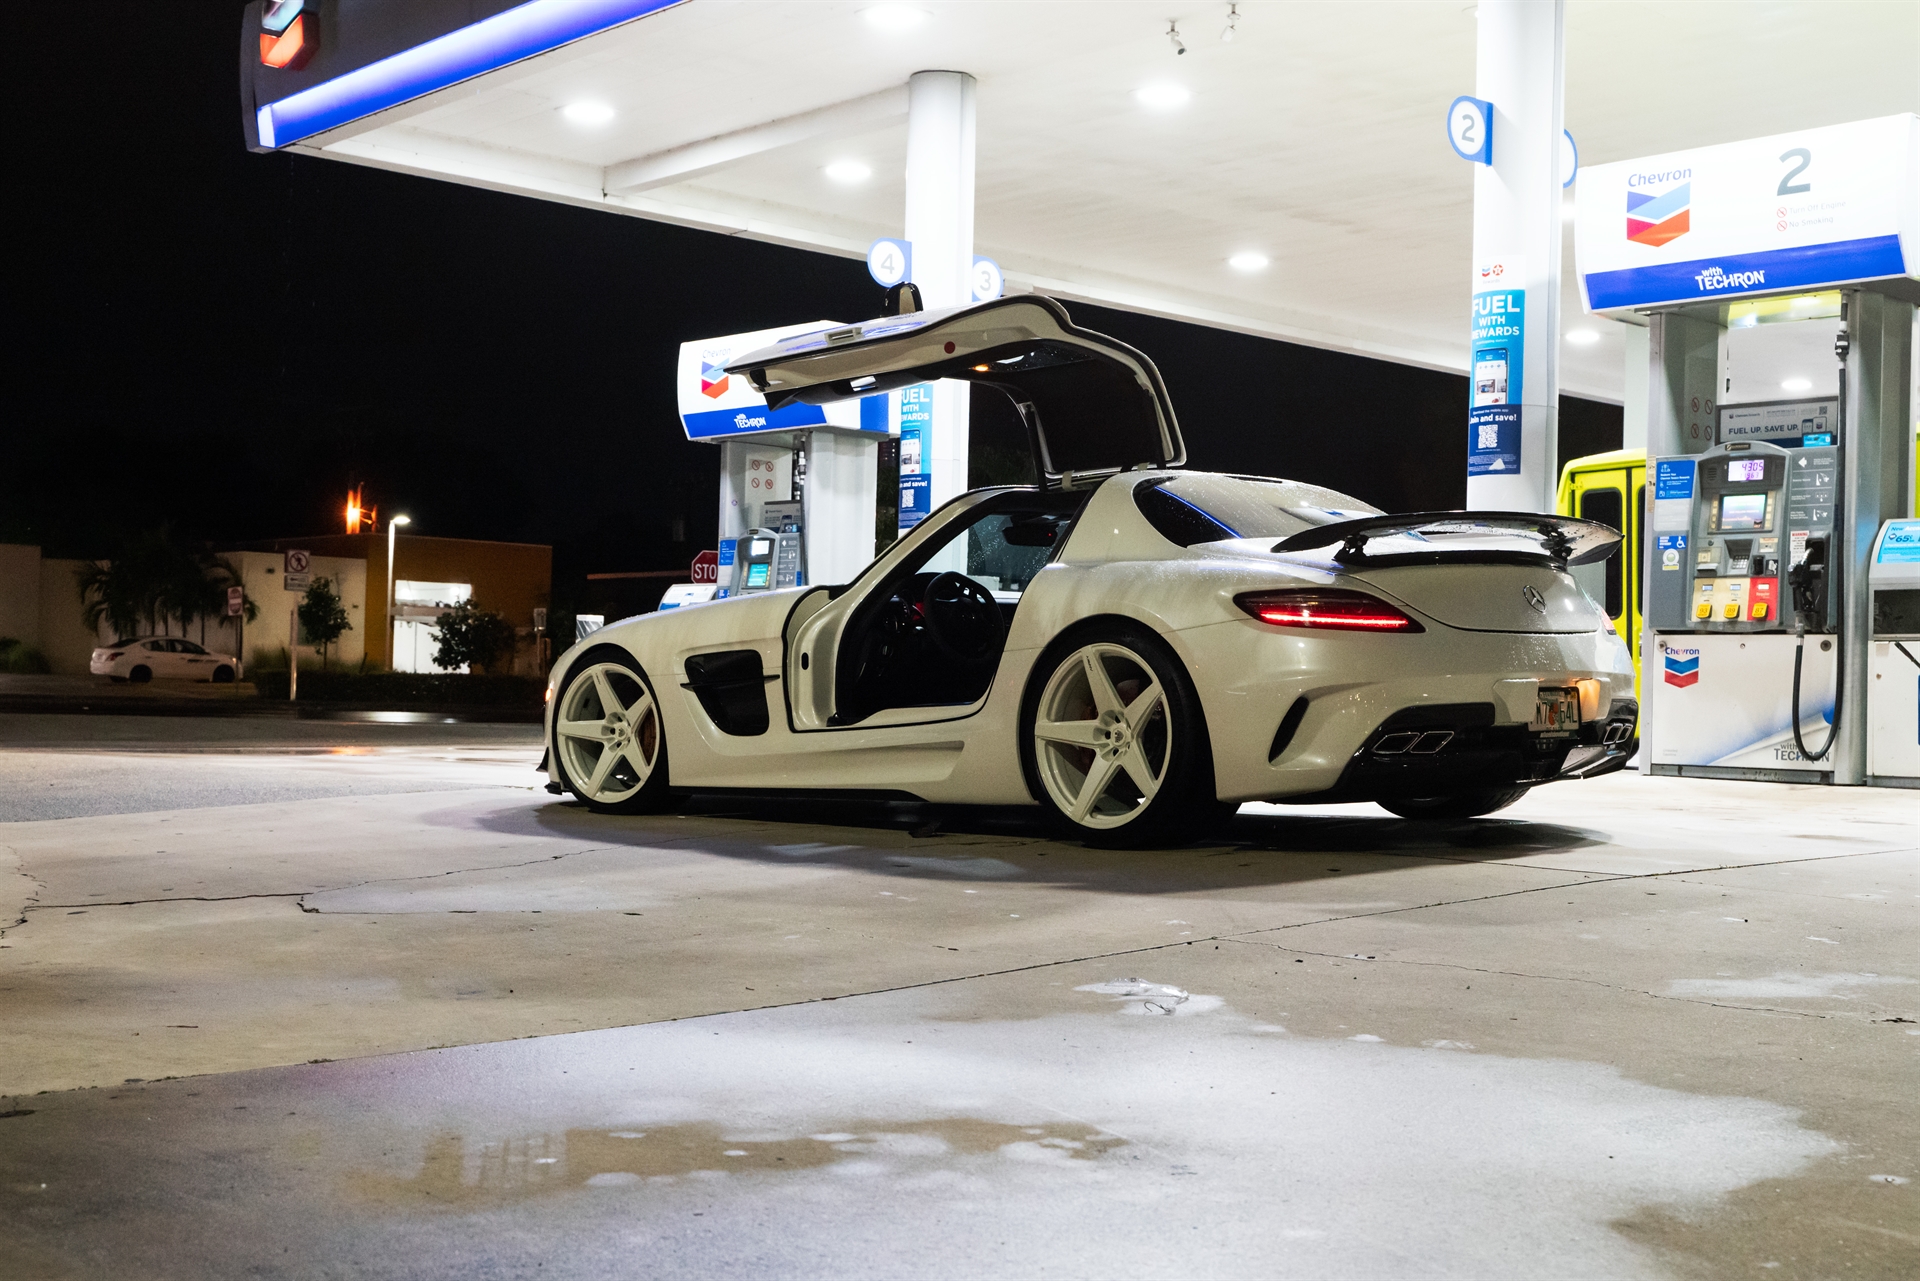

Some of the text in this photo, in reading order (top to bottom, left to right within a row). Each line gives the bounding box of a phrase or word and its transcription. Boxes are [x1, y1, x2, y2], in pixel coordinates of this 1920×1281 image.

[1461, 113, 1475, 142] 2
[1627, 168, 1692, 188] Chevron
[1776, 147, 1812, 197] 2
[1789, 200, 1847, 215] Turn Off Engine
[1801, 216, 1834, 227] Smoking
[880, 253, 895, 275] 4
[1702, 266, 1723, 278] with
[980, 270, 992, 292] 3
[1695, 269, 1765, 291] TECHRON
[1472, 294, 1521, 317] FUEL
[1478, 315, 1506, 327] WITH
[702, 347, 731, 359] Chevron
[902, 388, 930, 404] UEL
[733, 416, 767, 428] TECHRON
[1480, 413, 1494, 422] and
[1728, 427, 1749, 435] FUEL
[694, 563, 717, 580] STO
[1664, 646, 1700, 655] Chevron
